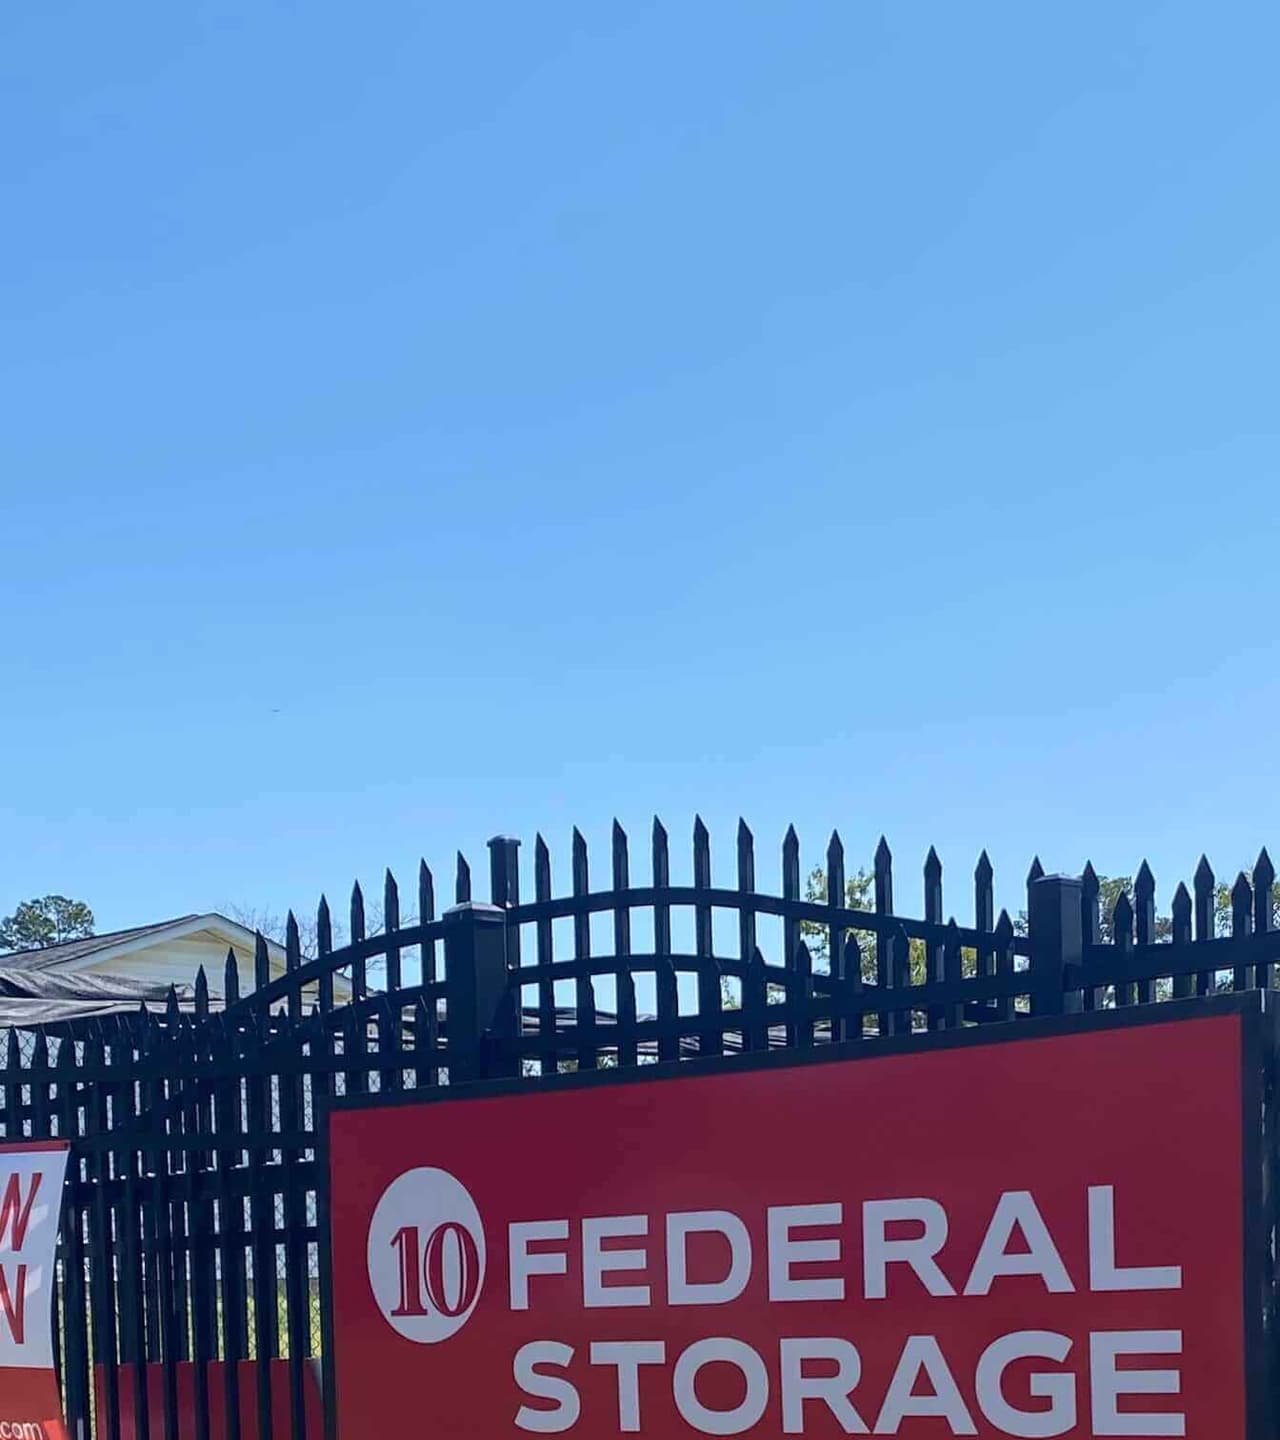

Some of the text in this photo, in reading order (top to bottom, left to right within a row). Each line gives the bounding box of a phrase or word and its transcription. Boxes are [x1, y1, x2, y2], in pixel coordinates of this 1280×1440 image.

[389, 1185, 1182, 1319] 10 FEDERAL
[512, 1329, 1187, 1438] STORAGE
